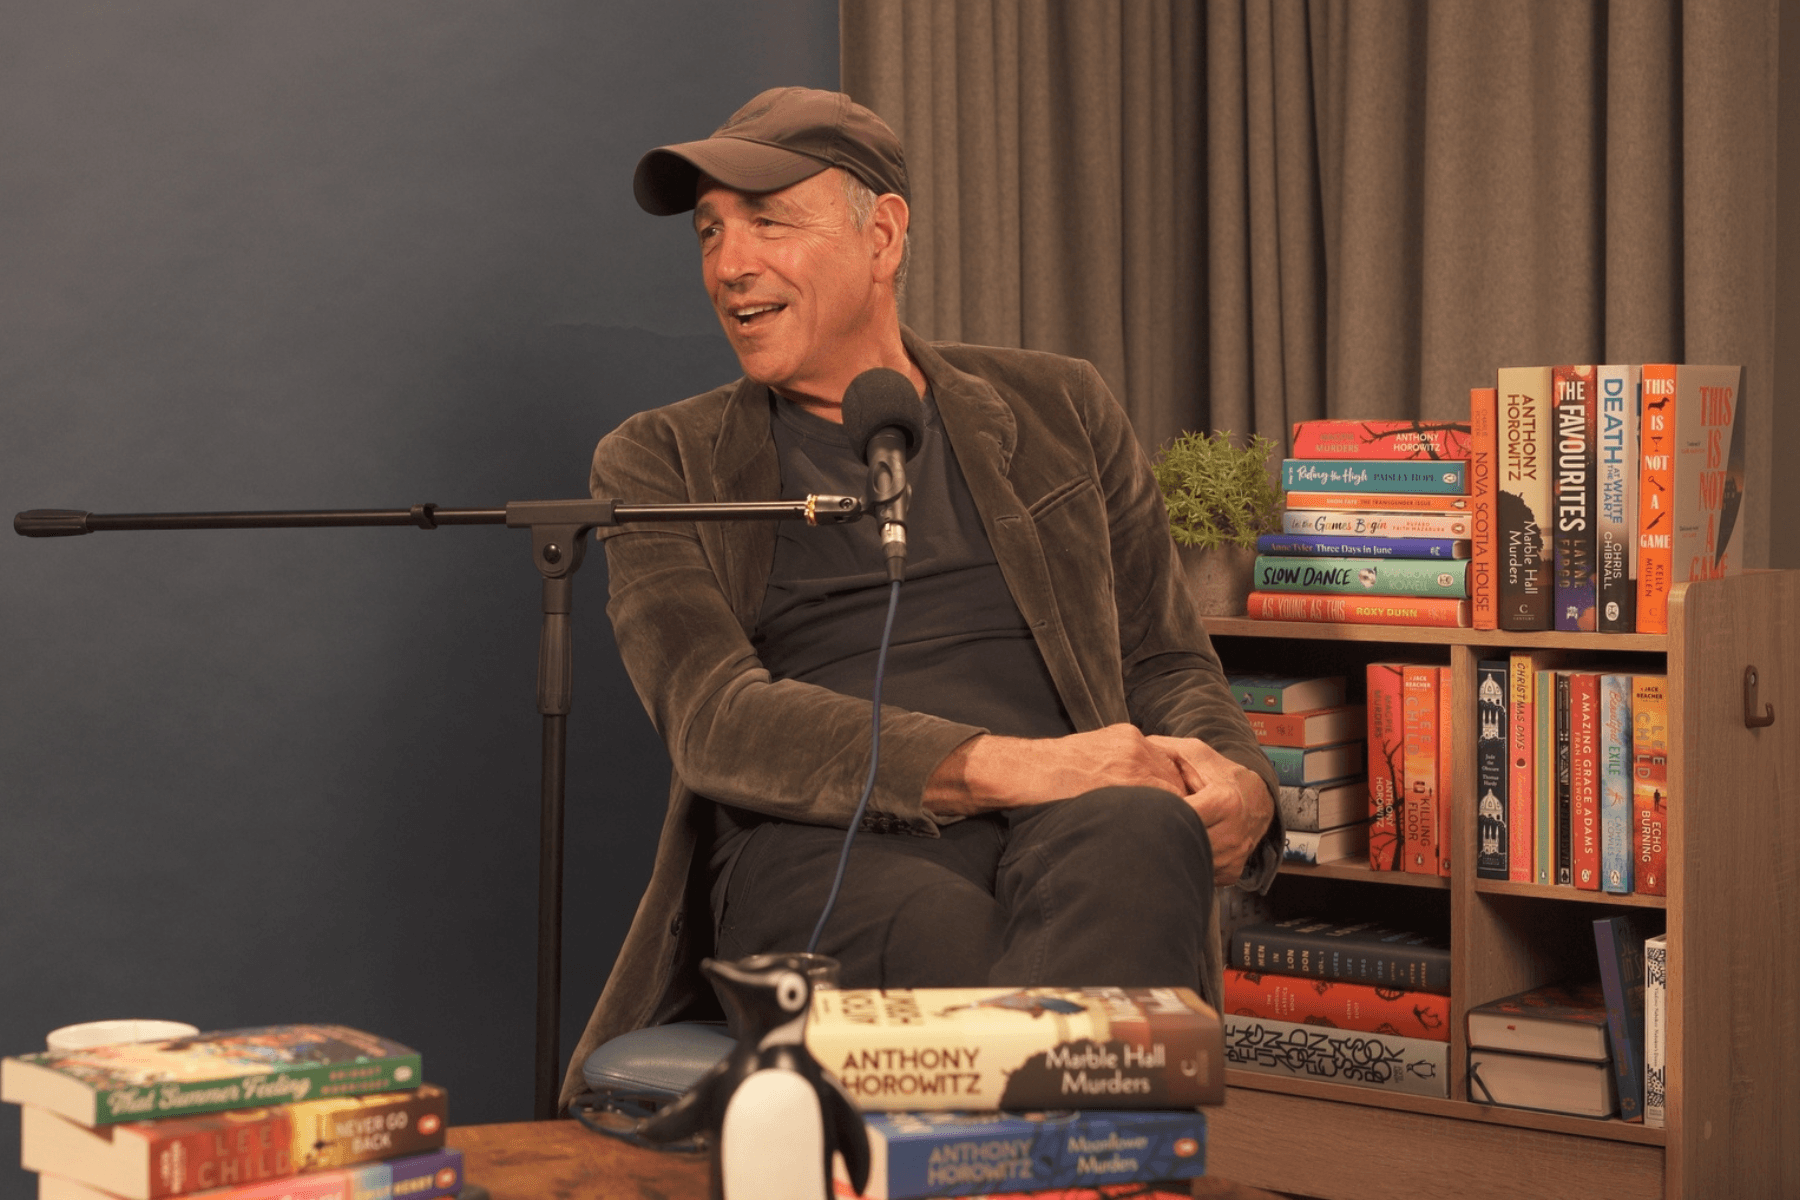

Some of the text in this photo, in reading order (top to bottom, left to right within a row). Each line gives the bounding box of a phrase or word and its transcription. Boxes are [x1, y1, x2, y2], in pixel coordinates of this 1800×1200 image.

[1560, 381, 1586, 400] THE
[1700, 386, 1733, 426] THIS
[1396, 433, 1440, 442] ANTHONY
[1508, 394, 1520, 482] HOROWITZ
[1523, 394, 1536, 480] ANTHONY
[1604, 379, 1623, 464] DEATH
[1316, 444, 1358, 452] MURDERS
[1393, 444, 1441, 452] HOROWITZ
[1640, 379, 1674, 548] THIS IS NOT A GAME
[1706, 430, 1722, 468] IS
[1296, 465, 1328, 486] Riding
[1331, 470, 1341, 480] the
[1342, 466, 1368, 486] High
[1475, 452, 1488, 498] NOVA
[1560, 404, 1586, 532] FAVOURITES
[1614, 468, 1620, 478] AT
[1604, 483, 1612, 519] HART
[1613, 479, 1623, 524] WHITE
[1699, 471, 1727, 511] NOT
[1315, 516, 1352, 532] Games
[1475, 503, 1488, 555] SCOTIA
[1706, 514, 1715, 552] A
[1316, 544, 1392, 556] Three Days in June
[1508, 530, 1520, 584] Murders
[1524, 521, 1538, 594] Marble Hall
[1558, 539, 1572, 588] FARGO
[1574, 540, 1587, 589] LAYNE
[1604, 531, 1612, 590] CHIBNALL
[1613, 543, 1622, 578] CHRIS
[1262, 566, 1352, 586] SLOW DANCE
[1476, 562, 1490, 612] HOUSE
[1262, 600, 1346, 620] AS YOUNG AS THIS
[1356, 607, 1418, 617] ROXY DUNN
[1519, 604, 1528, 614] C
[1516, 662, 1526, 750] CHRISTMAS DAYS
[1405, 696, 1418, 756] CHILD
[1421, 708, 1432, 743] LEE
[1608, 746, 1620, 776] EXILE
[1635, 712, 1650, 779] CHILD
[1652, 725, 1664, 766] LEE
[1582, 692, 1594, 854] AMAZING GRACE ADAMS
[1376, 777, 1384, 828] HOROWITZ
[1408, 802, 1418, 840] FLOOR
[1420, 798, 1431, 847] KILLING
[1641, 810, 1652, 862] BURNING
[1652, 821, 1662, 853] ECHO
[1258, 944, 1266, 967] MEN
[1272, 952, 1280, 963] IN
[1286, 950, 1294, 970] LON
[842, 1045, 981, 1071] ANTHONY
[1045, 1043, 1118, 1070] Marble
[1123, 1042, 1166, 1069] Hall
[158, 1083, 242, 1111] Summer
[242, 1074, 312, 1101] Feeling
[840, 1072, 981, 1096] HOROWITZ
[1060, 1071, 1151, 1096] Murders
[215, 1124, 272, 1157] LEE
[335, 1110, 409, 1137] NEVER GO
[351, 1133, 392, 1155] BACK
[929, 1138, 1035, 1167] ANTHONY
[197, 1151, 292, 1188] CHILD
[927, 1160, 1035, 1188] HOROWITZ
